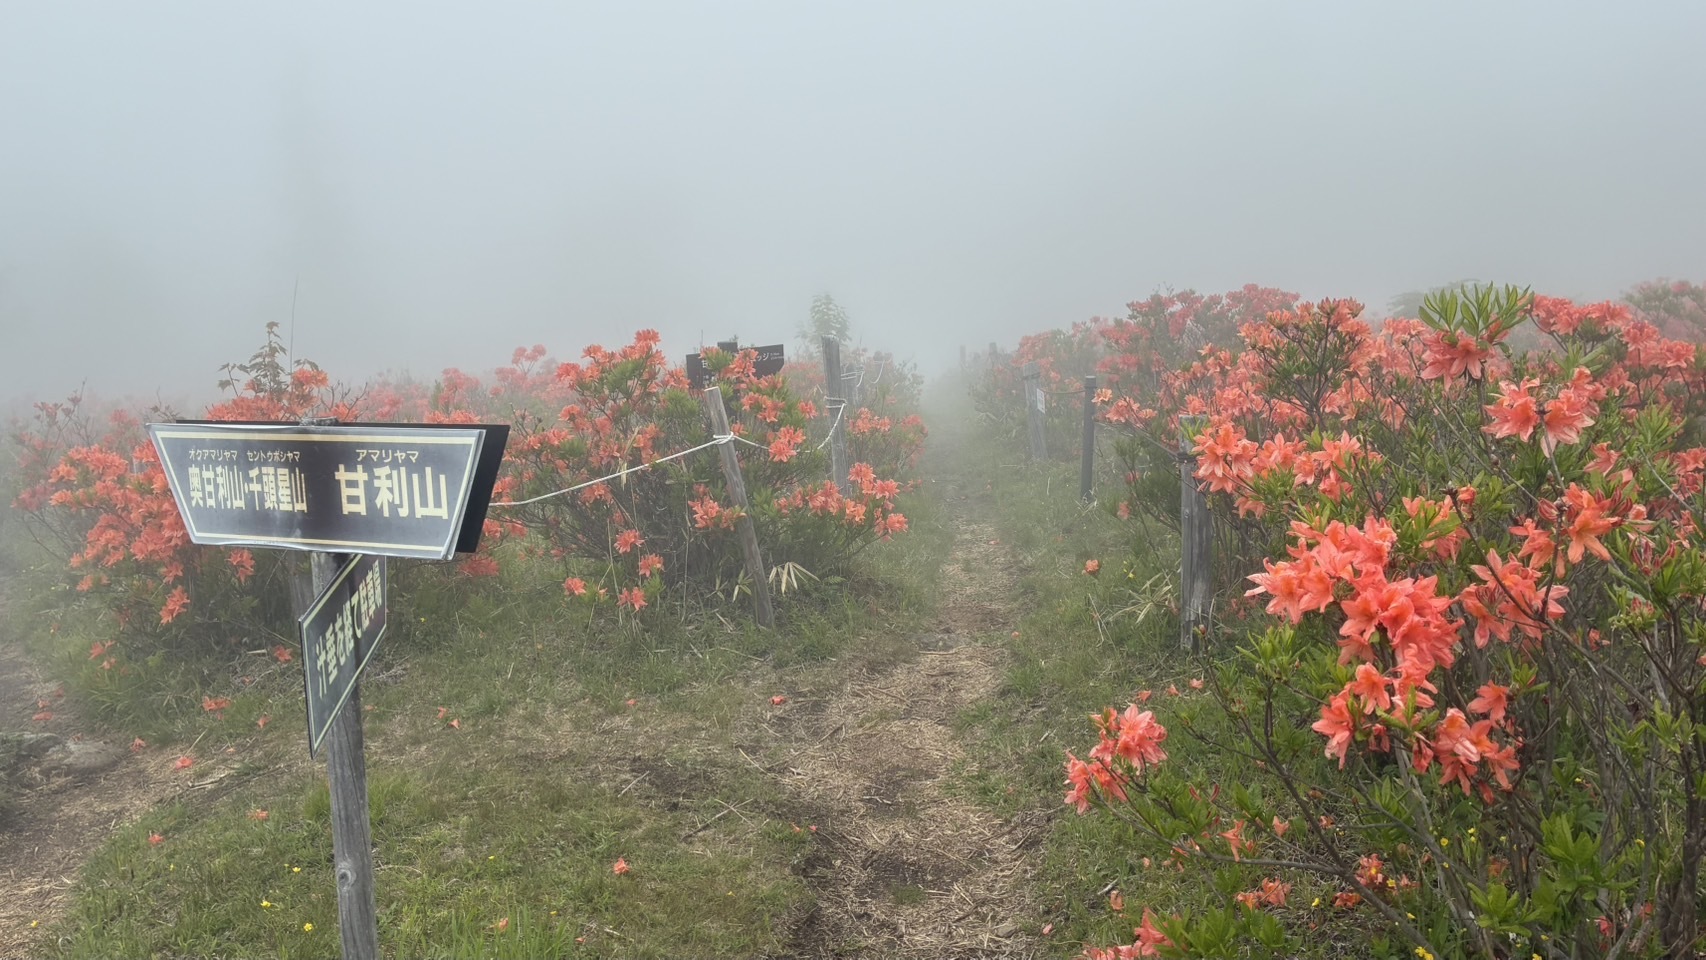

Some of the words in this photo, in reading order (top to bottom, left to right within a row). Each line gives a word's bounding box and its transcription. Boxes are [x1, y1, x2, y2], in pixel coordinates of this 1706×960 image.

[188, 448, 238, 462] オクアマリヤマ
[355, 448, 419, 464] アマリヤマ
[334, 463, 449, 520] 甘利山
